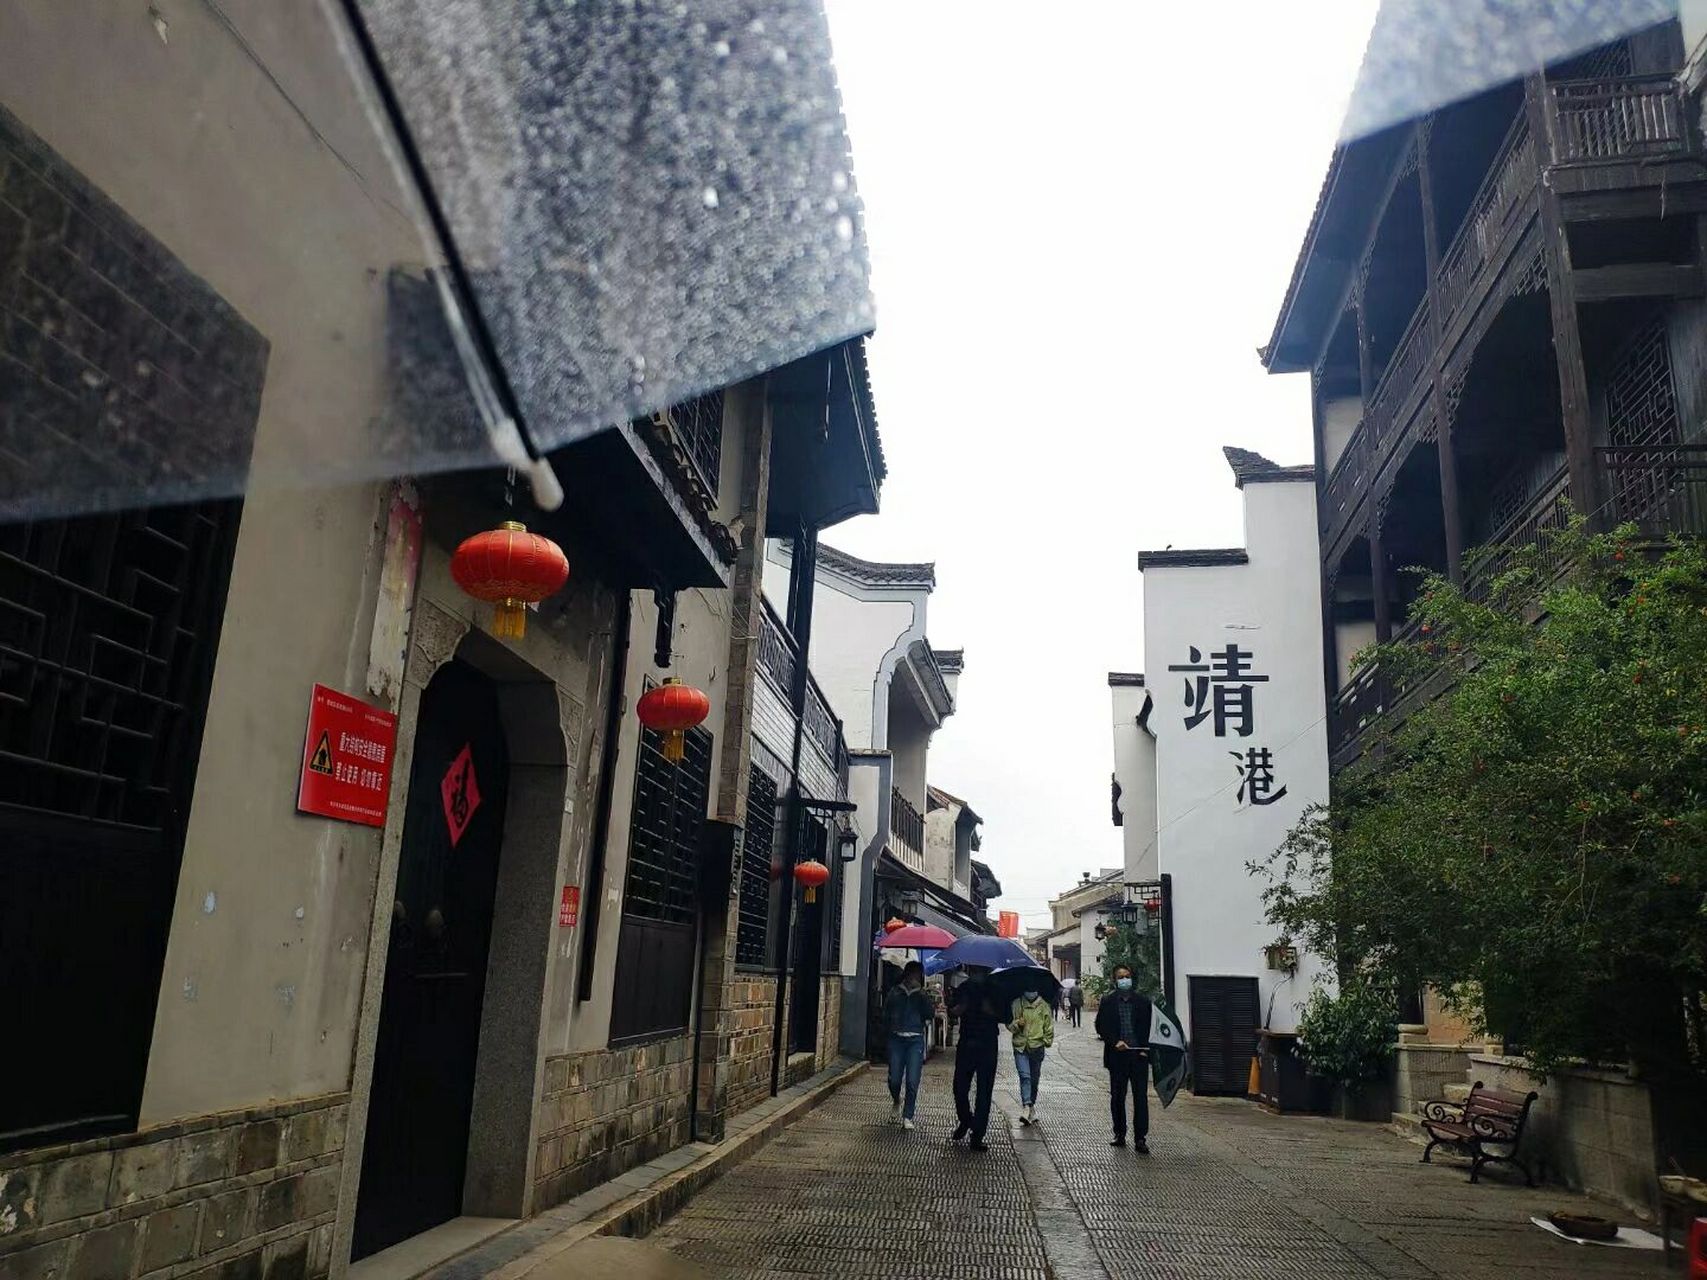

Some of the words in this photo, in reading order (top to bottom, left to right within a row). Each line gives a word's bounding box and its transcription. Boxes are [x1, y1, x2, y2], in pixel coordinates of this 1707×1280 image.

[1168, 643, 1287, 806] 靖港
[335, 761, 359, 785] 禁止使用
